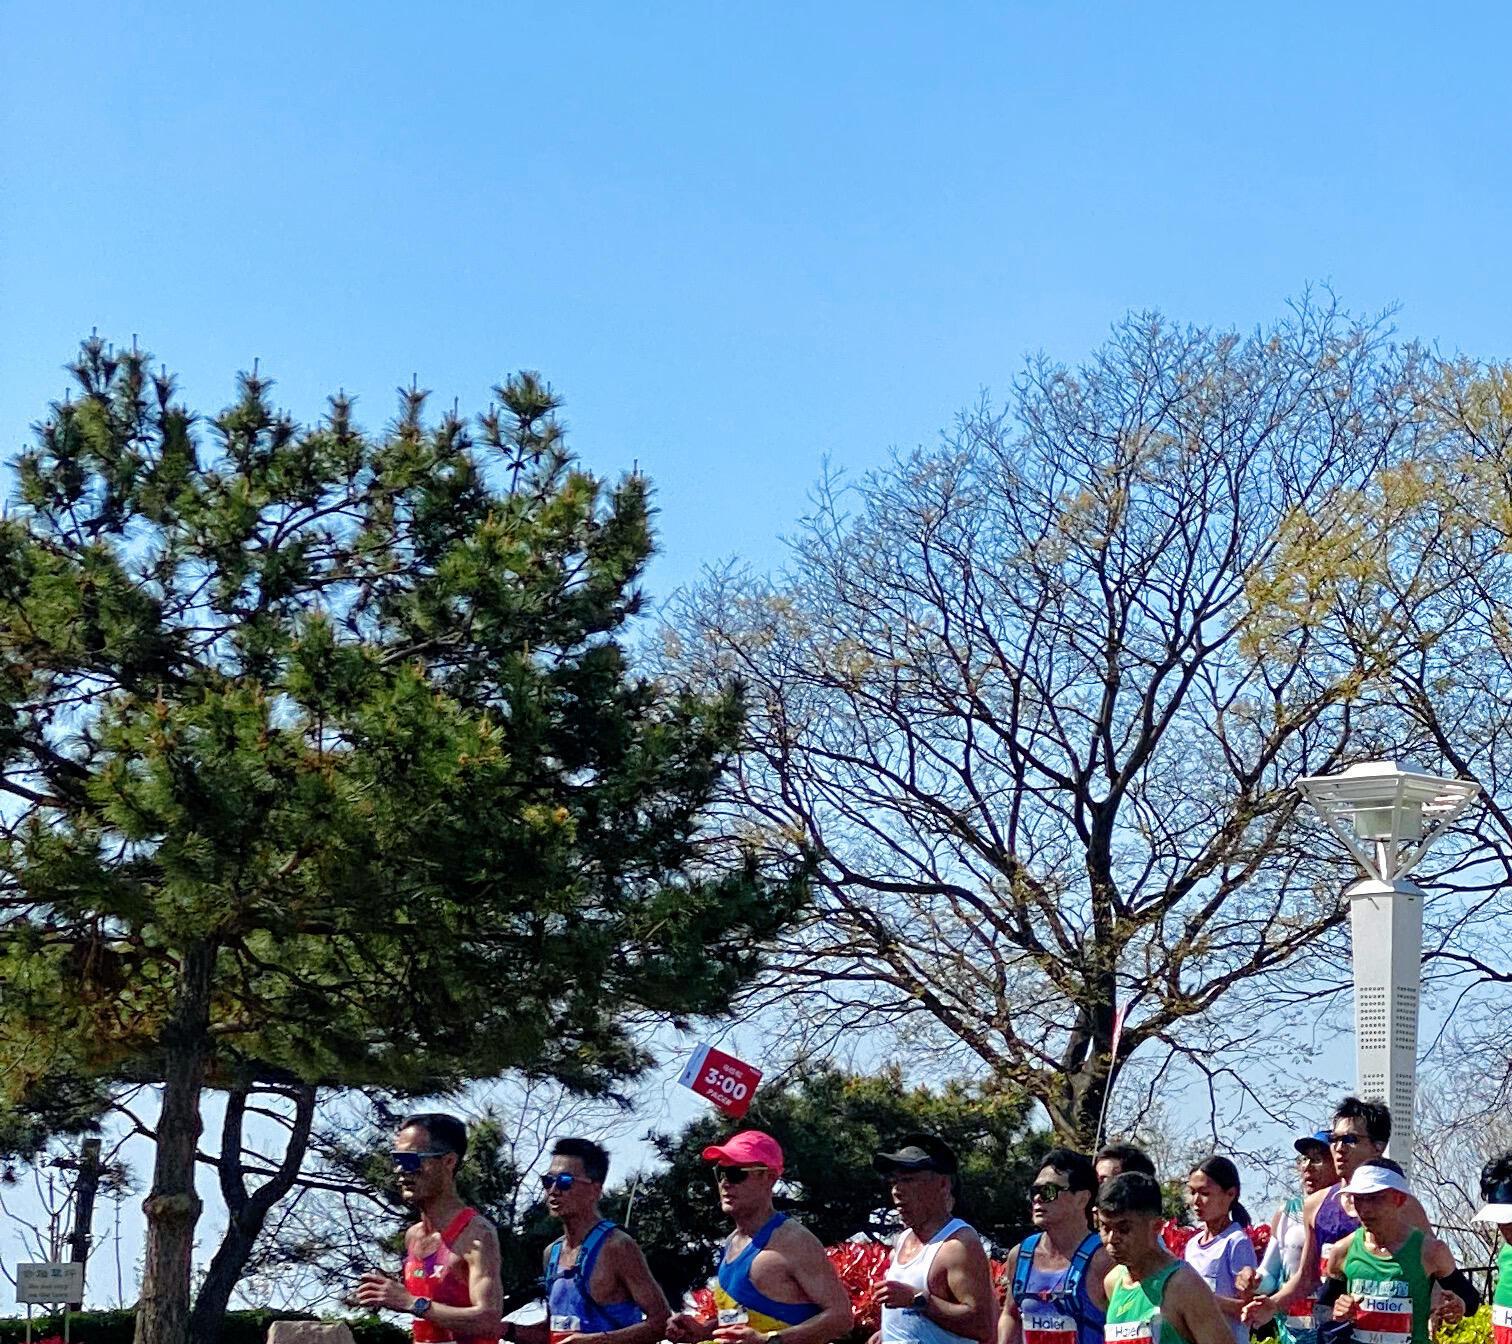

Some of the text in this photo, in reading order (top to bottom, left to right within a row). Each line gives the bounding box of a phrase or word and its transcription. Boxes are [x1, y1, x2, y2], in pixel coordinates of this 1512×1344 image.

[704, 1067, 747, 1101] 3:00
[705, 1088, 733, 1106] PACER
[1366, 1299, 1403, 1311] Haier
[1032, 1316, 1065, 1330] Haier
